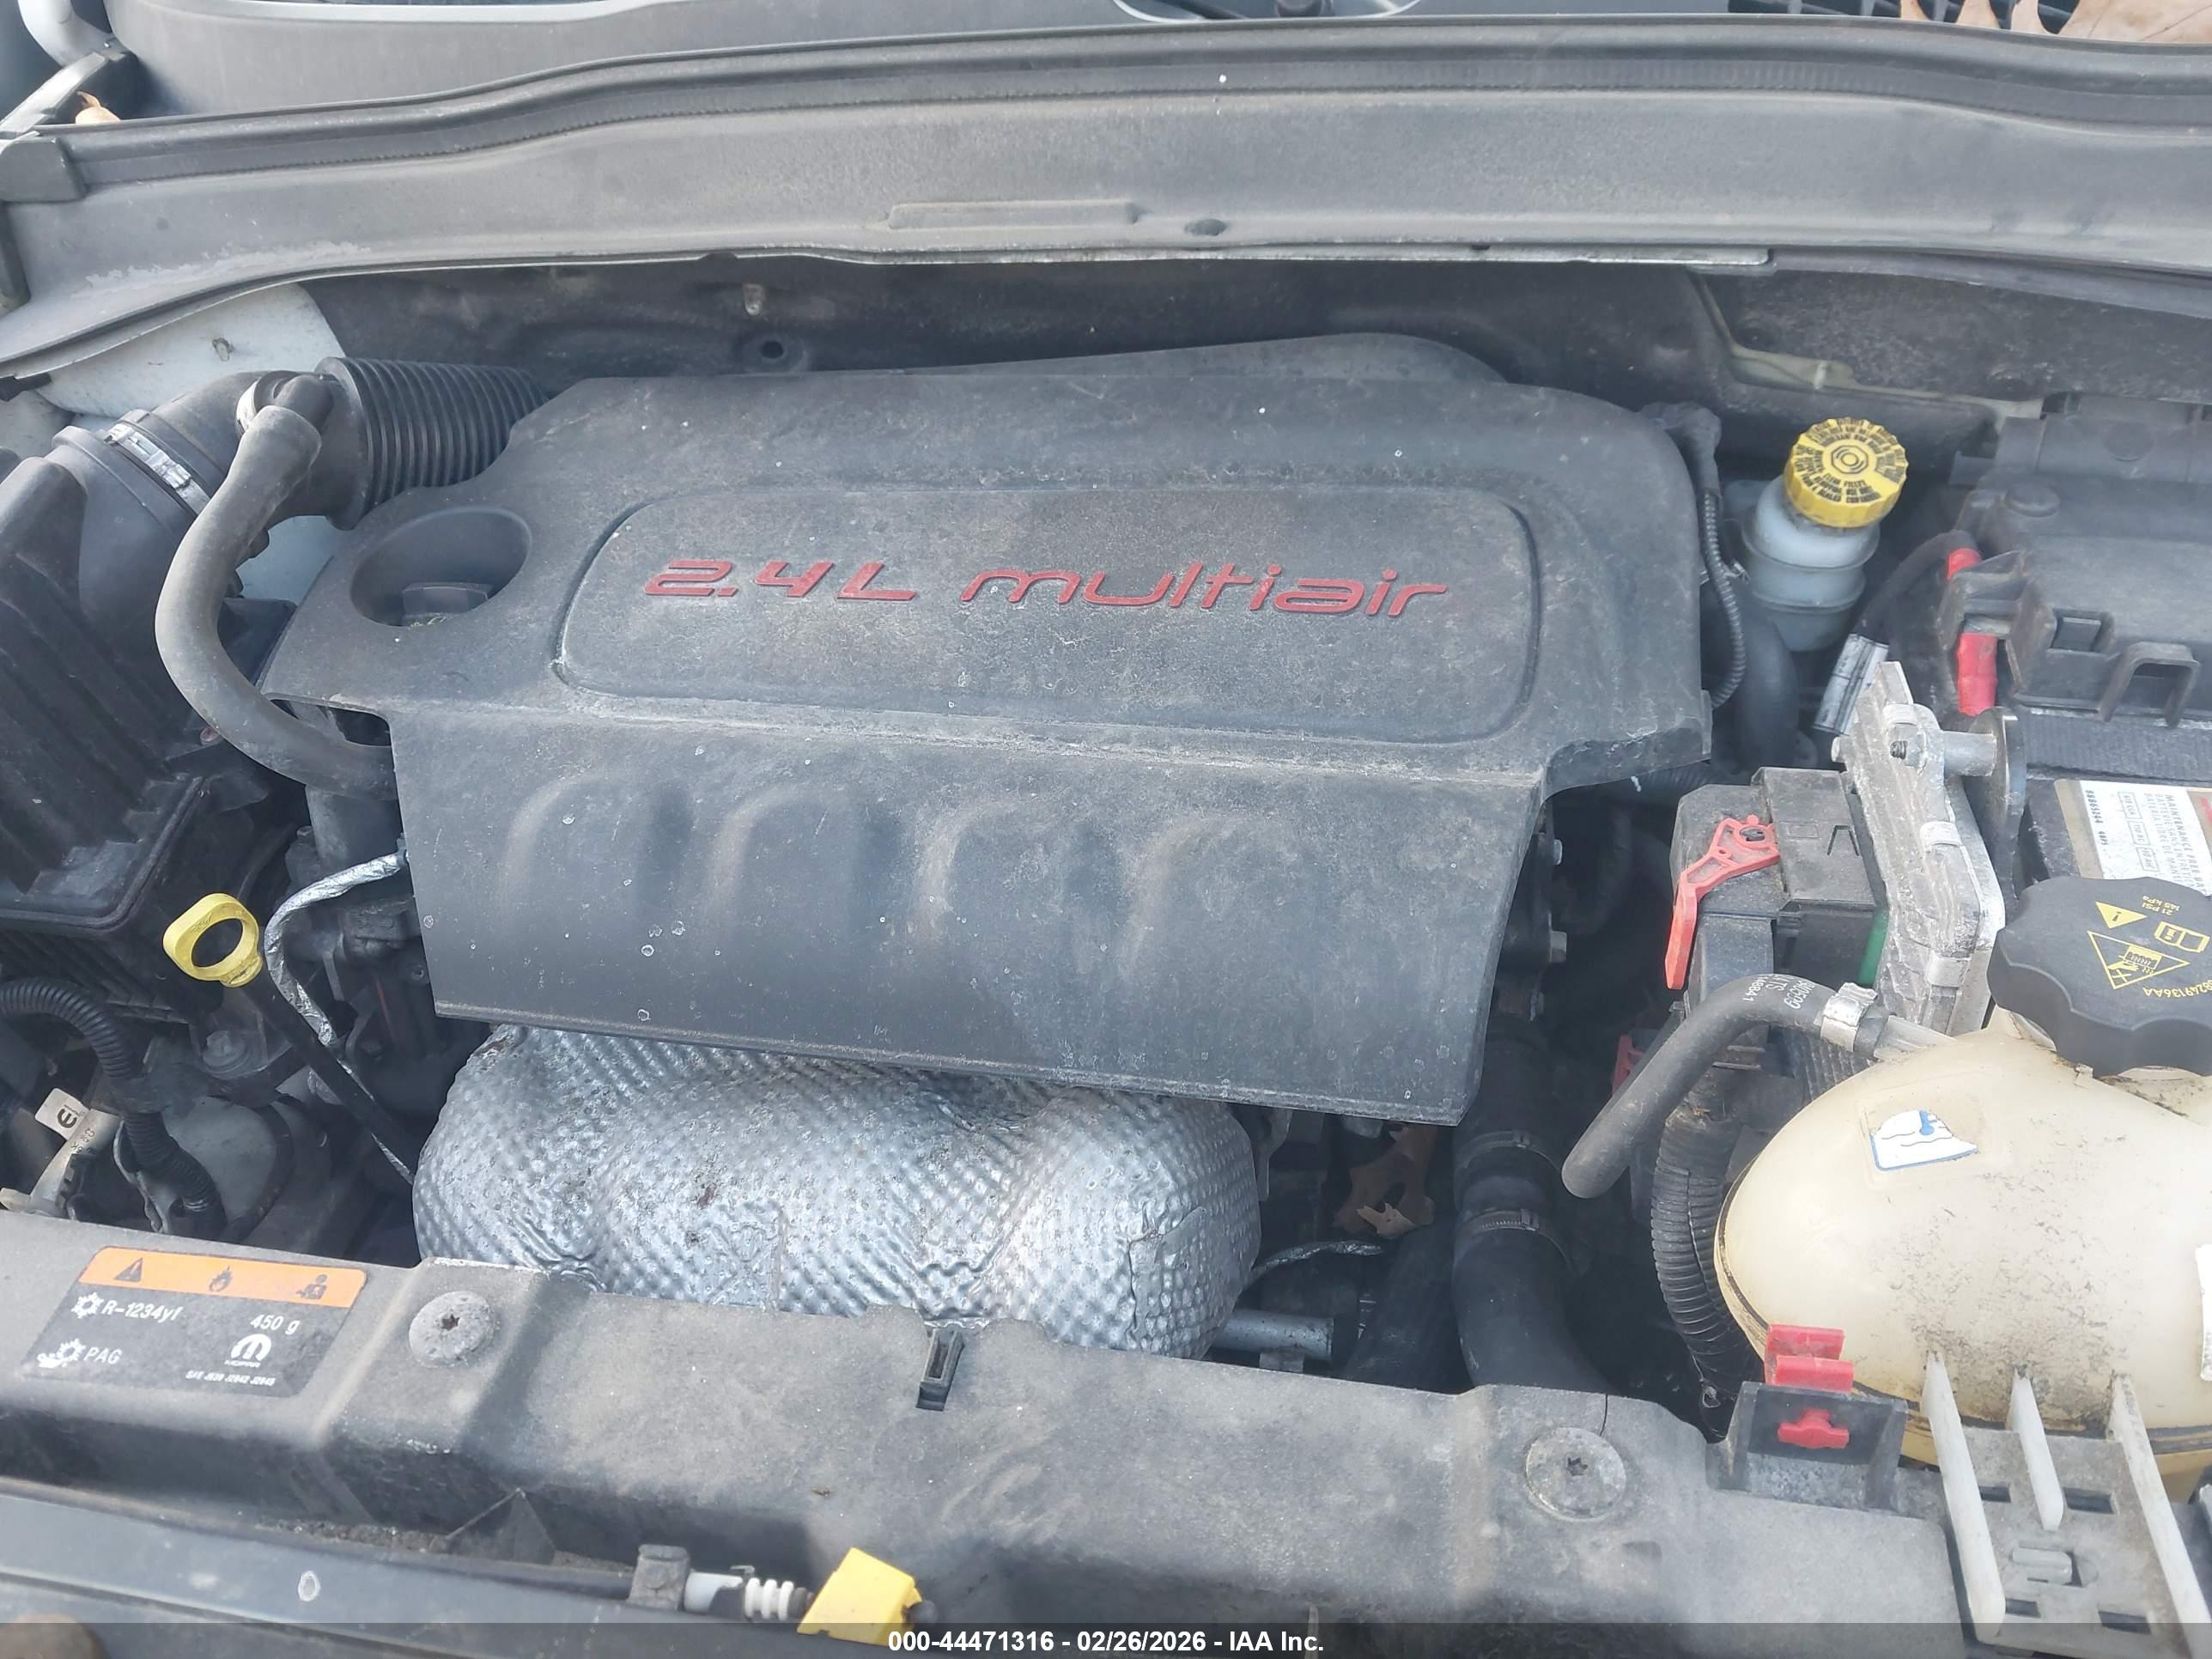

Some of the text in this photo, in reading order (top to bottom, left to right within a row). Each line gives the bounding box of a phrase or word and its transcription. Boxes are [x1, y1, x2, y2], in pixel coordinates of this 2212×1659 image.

[644, 560, 1448, 617] 2.4L multiair
[2165, 794, 2193, 852] MAINTENANCE
[2186, 854, 2201, 874] FREE
[100, 1299, 301, 1334] R-1234yf 450 g
[82, 1346, 124, 1364] PAG
